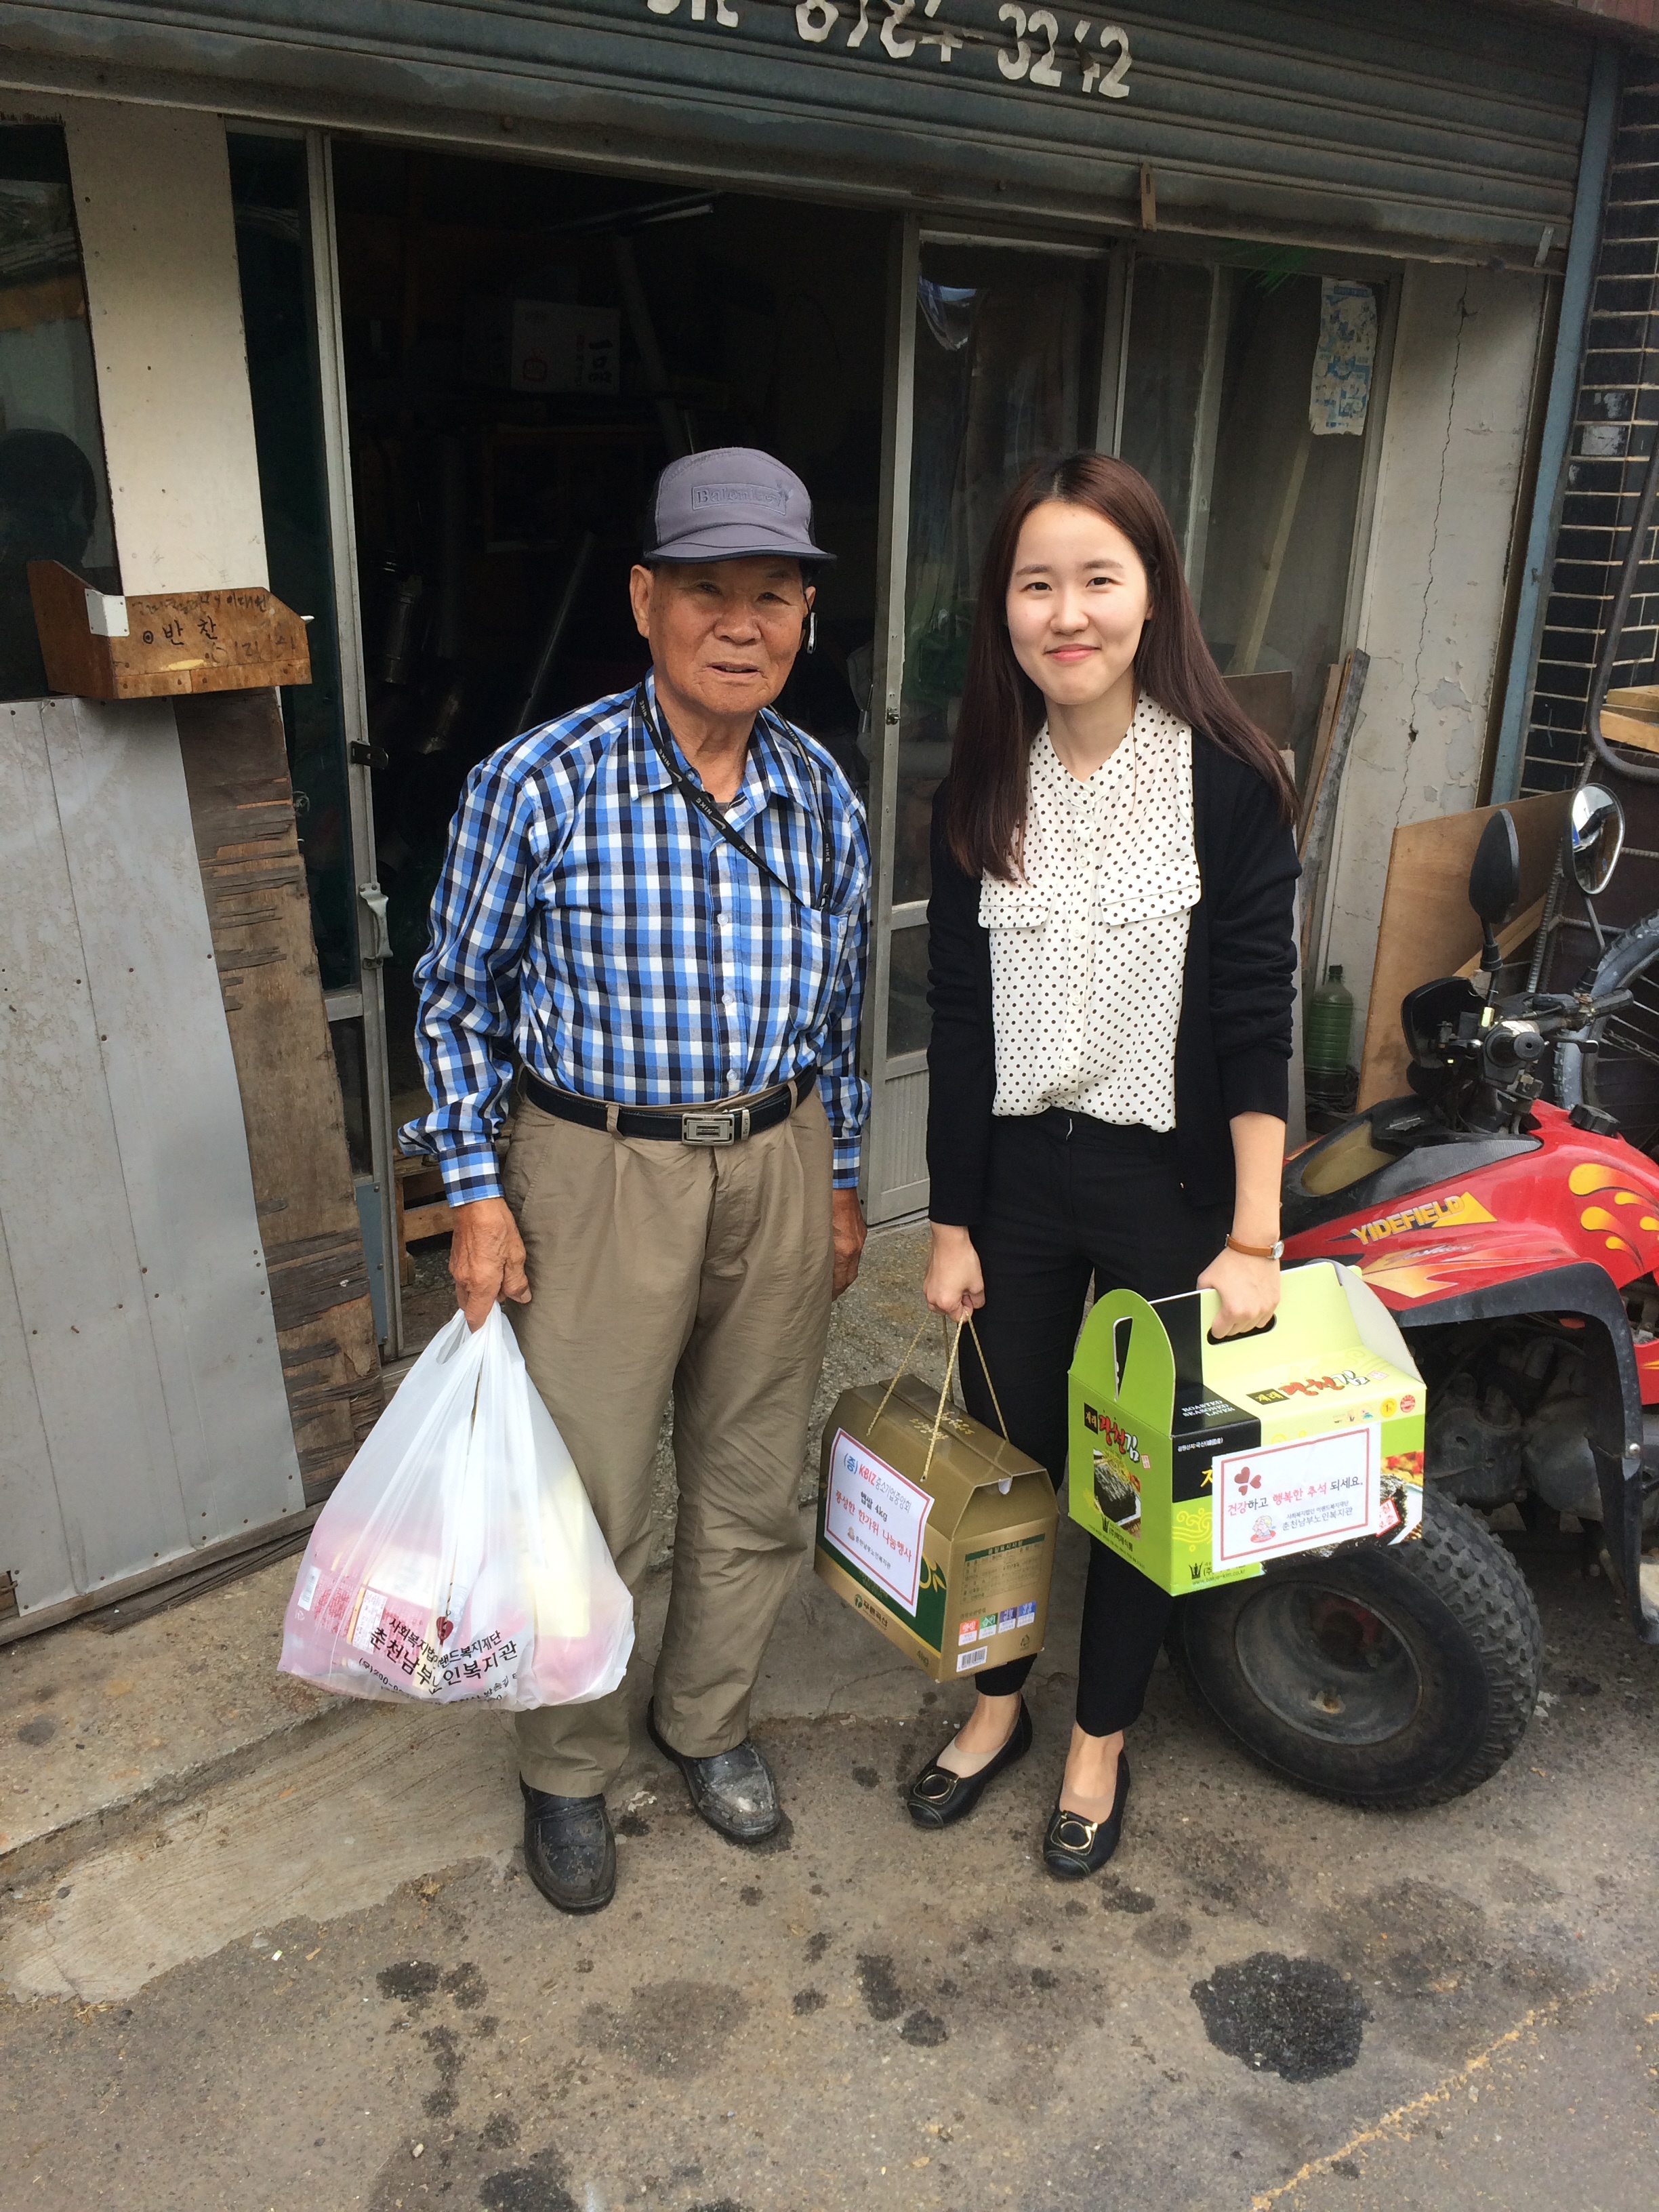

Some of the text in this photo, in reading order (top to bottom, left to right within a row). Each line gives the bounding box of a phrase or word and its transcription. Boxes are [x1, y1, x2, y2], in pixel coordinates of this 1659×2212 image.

[639, 700, 647, 717] NIKE
[658, 748, 671, 767] NIKE
[695, 797, 712, 815] NIKE
[739, 844, 756, 860] NIKE
[1350, 1195, 1465, 1245] YIDEFIELD
[859, 1464, 877, 1486] KBIZ
[876, 1477, 912, 1513] 중소기업중앙회
[1227, 1476, 1364, 1517] 건강하고 행복한 추석 되세요.
[836, 1490, 855, 1515] 풍성한
[859, 1509, 879, 1536] 한가위
[861, 1491, 888, 1522] 햅쌀 4kg
[1282, 1506, 1353, 1531] 춘천남부노인복지관
